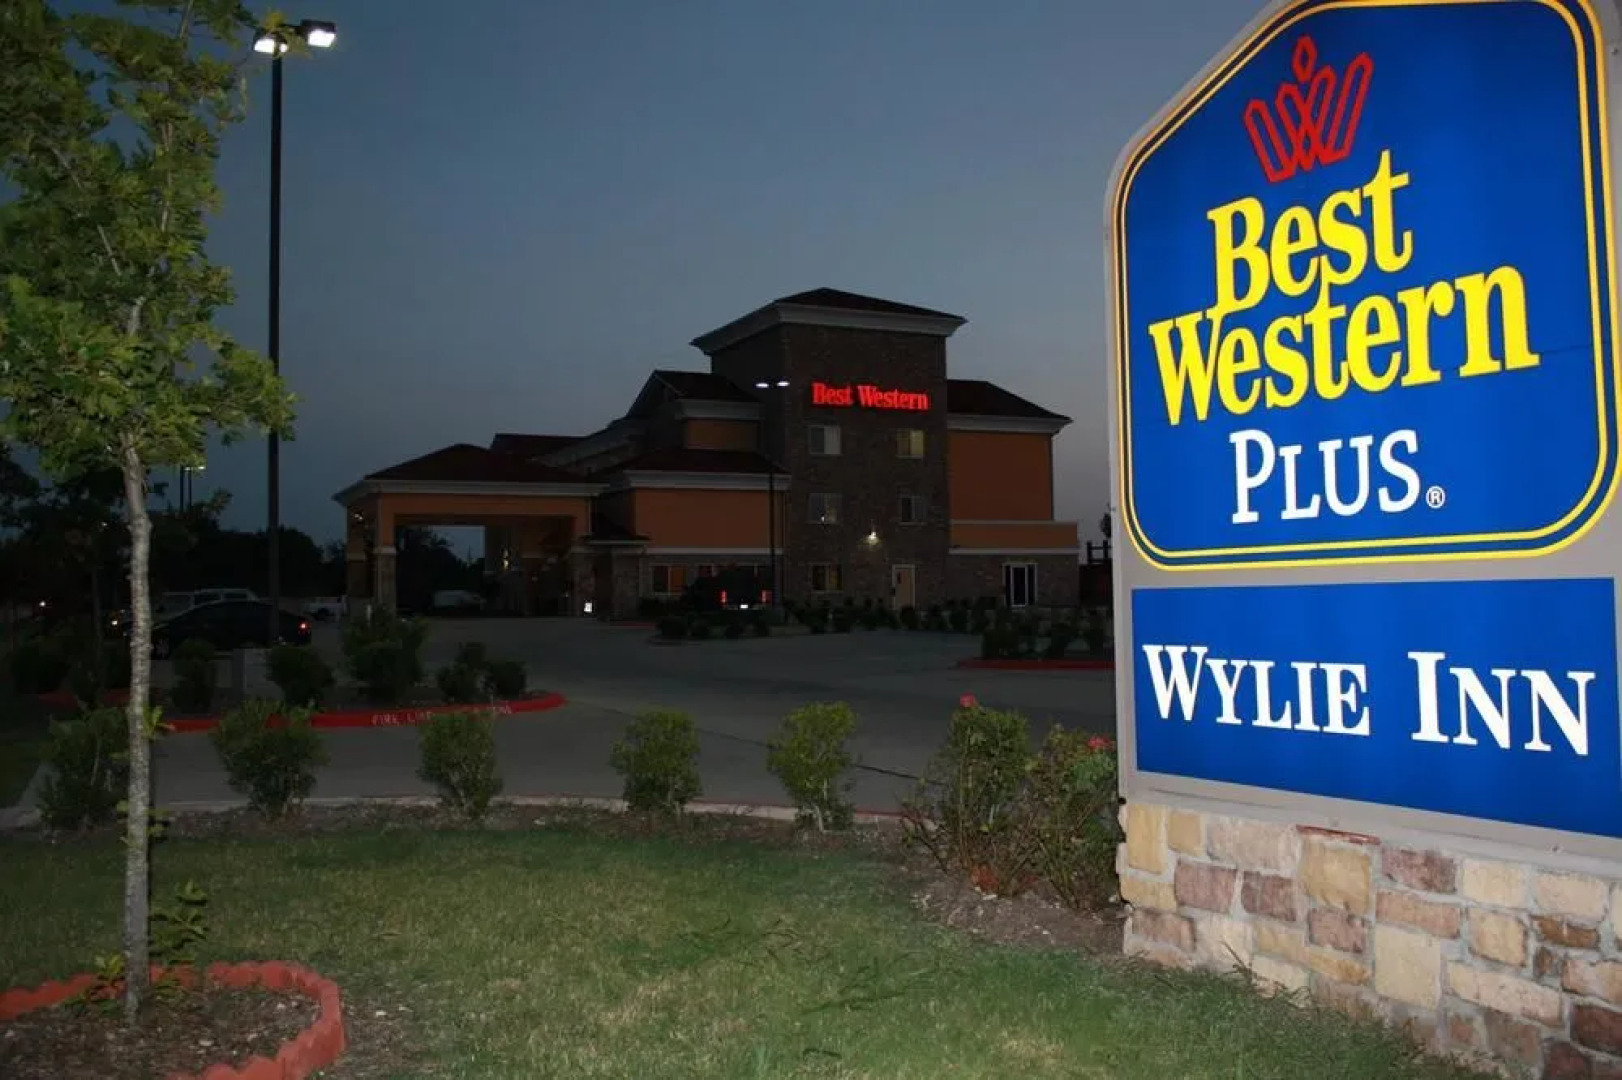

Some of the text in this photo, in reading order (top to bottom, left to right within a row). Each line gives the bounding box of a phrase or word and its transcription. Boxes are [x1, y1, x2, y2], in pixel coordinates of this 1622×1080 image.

[1207, 149, 1413, 311] Best
[813, 383, 929, 410] Best Western
[1149, 265, 1540, 426] Western
[1142, 644, 1596, 756] WYLIE INN
